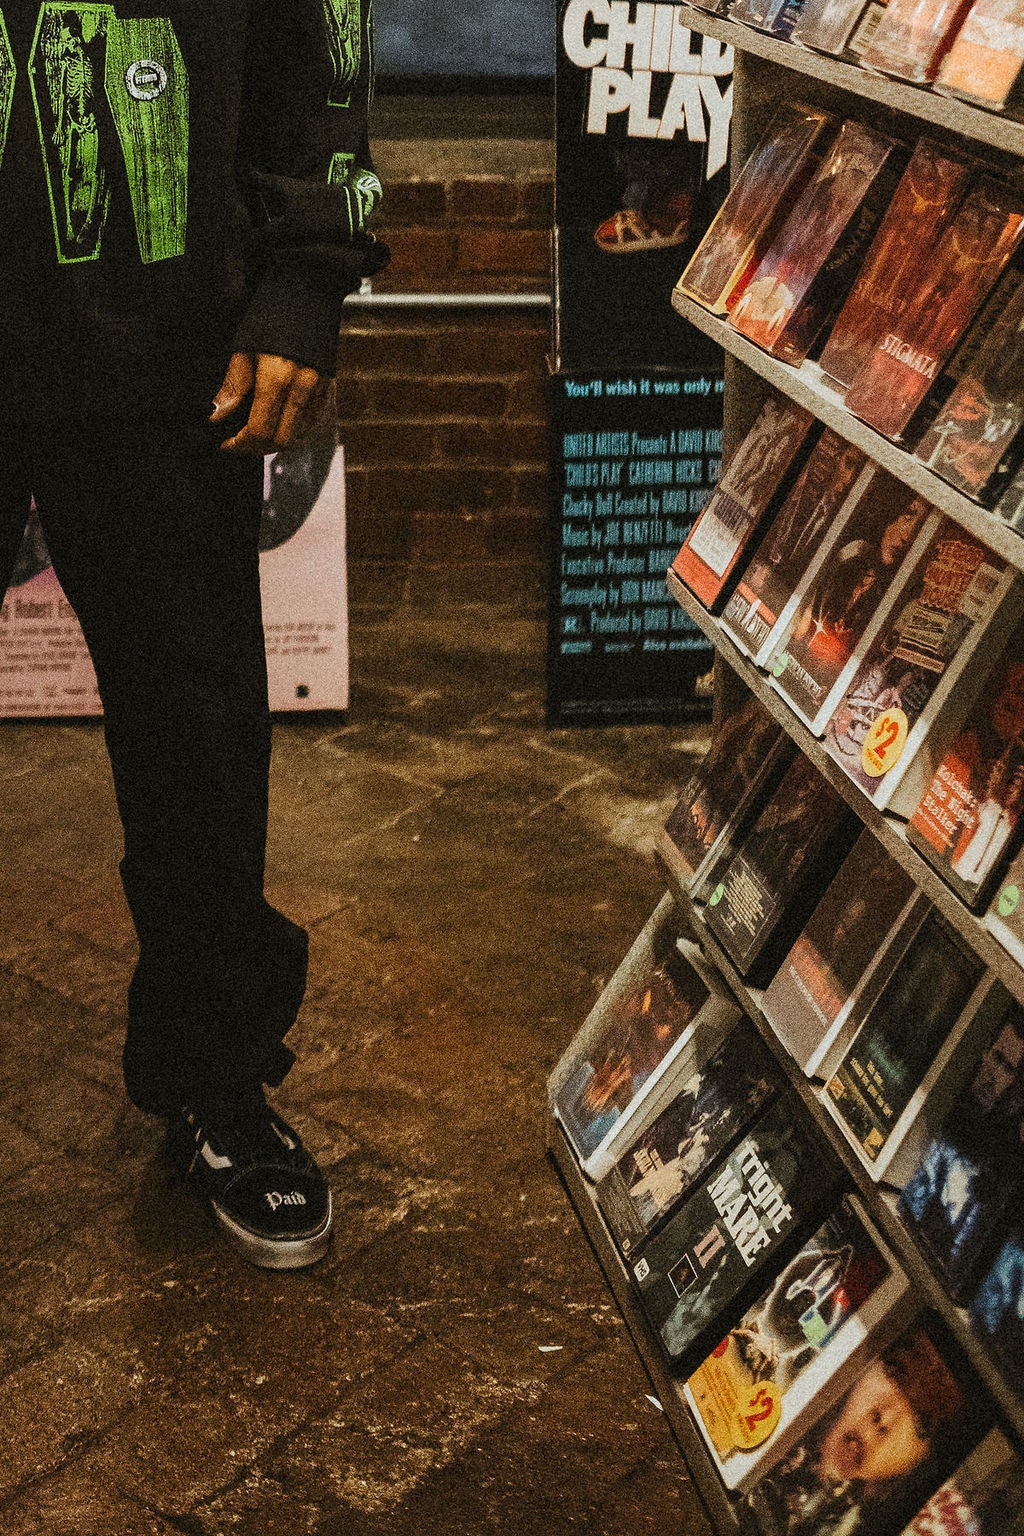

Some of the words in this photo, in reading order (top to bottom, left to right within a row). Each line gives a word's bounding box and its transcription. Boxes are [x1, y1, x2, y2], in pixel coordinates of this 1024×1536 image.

[586, 67, 733, 181] PLAY
[565, 379, 603, 397] You'll
[606, 378, 637, 396] wish
[640, 377, 651, 395] it
[654, 381, 681, 395] was
[683, 377, 711, 397] only
[264, 1191, 307, 1211] Paid
[706, 1164, 772, 1268] MARE
